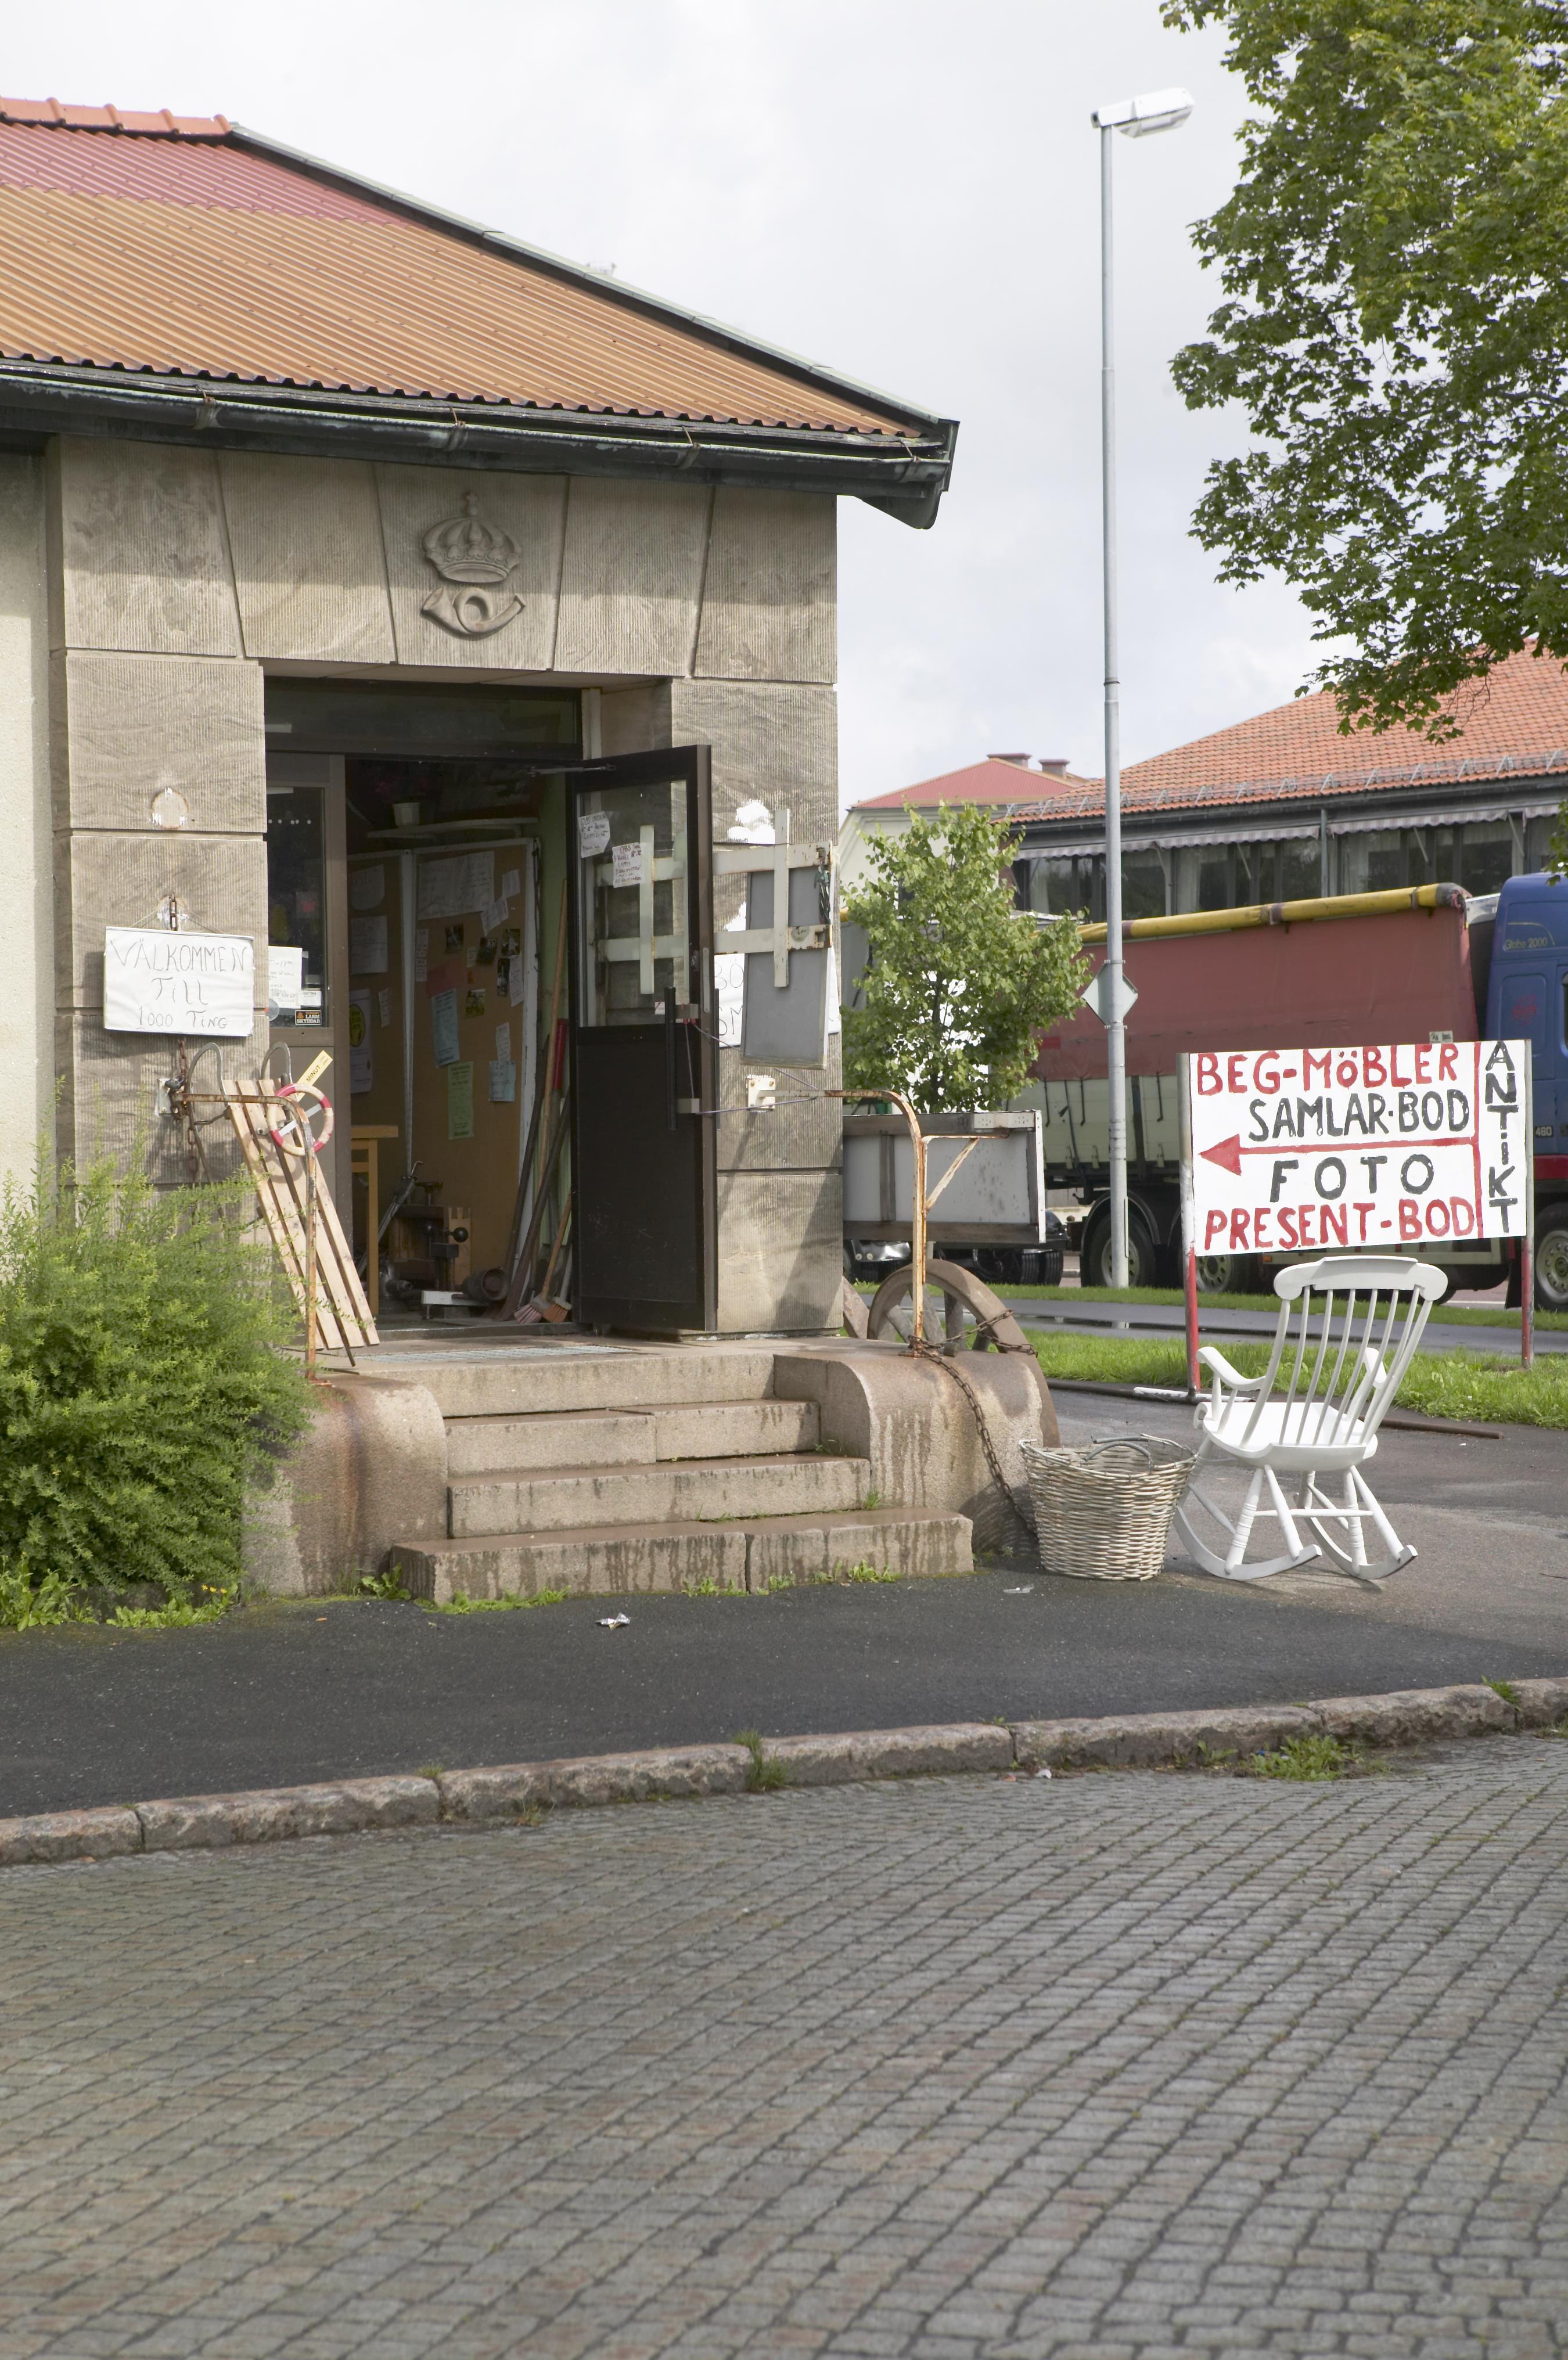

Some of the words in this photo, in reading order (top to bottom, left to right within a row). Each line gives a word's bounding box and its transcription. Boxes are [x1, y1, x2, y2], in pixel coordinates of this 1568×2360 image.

[620, 845, 631, 854] OBS
[110, 938, 247, 972] VÄLKOMMEN
[1505, 939, 1526, 950] Globe
[1529, 937, 1548, 948] 2000
[137, 1006, 173, 1027] 1000
[1269, 1154, 1434, 1203] FOTO
[1204, 1197, 1475, 1251] PRESENT-BOD
